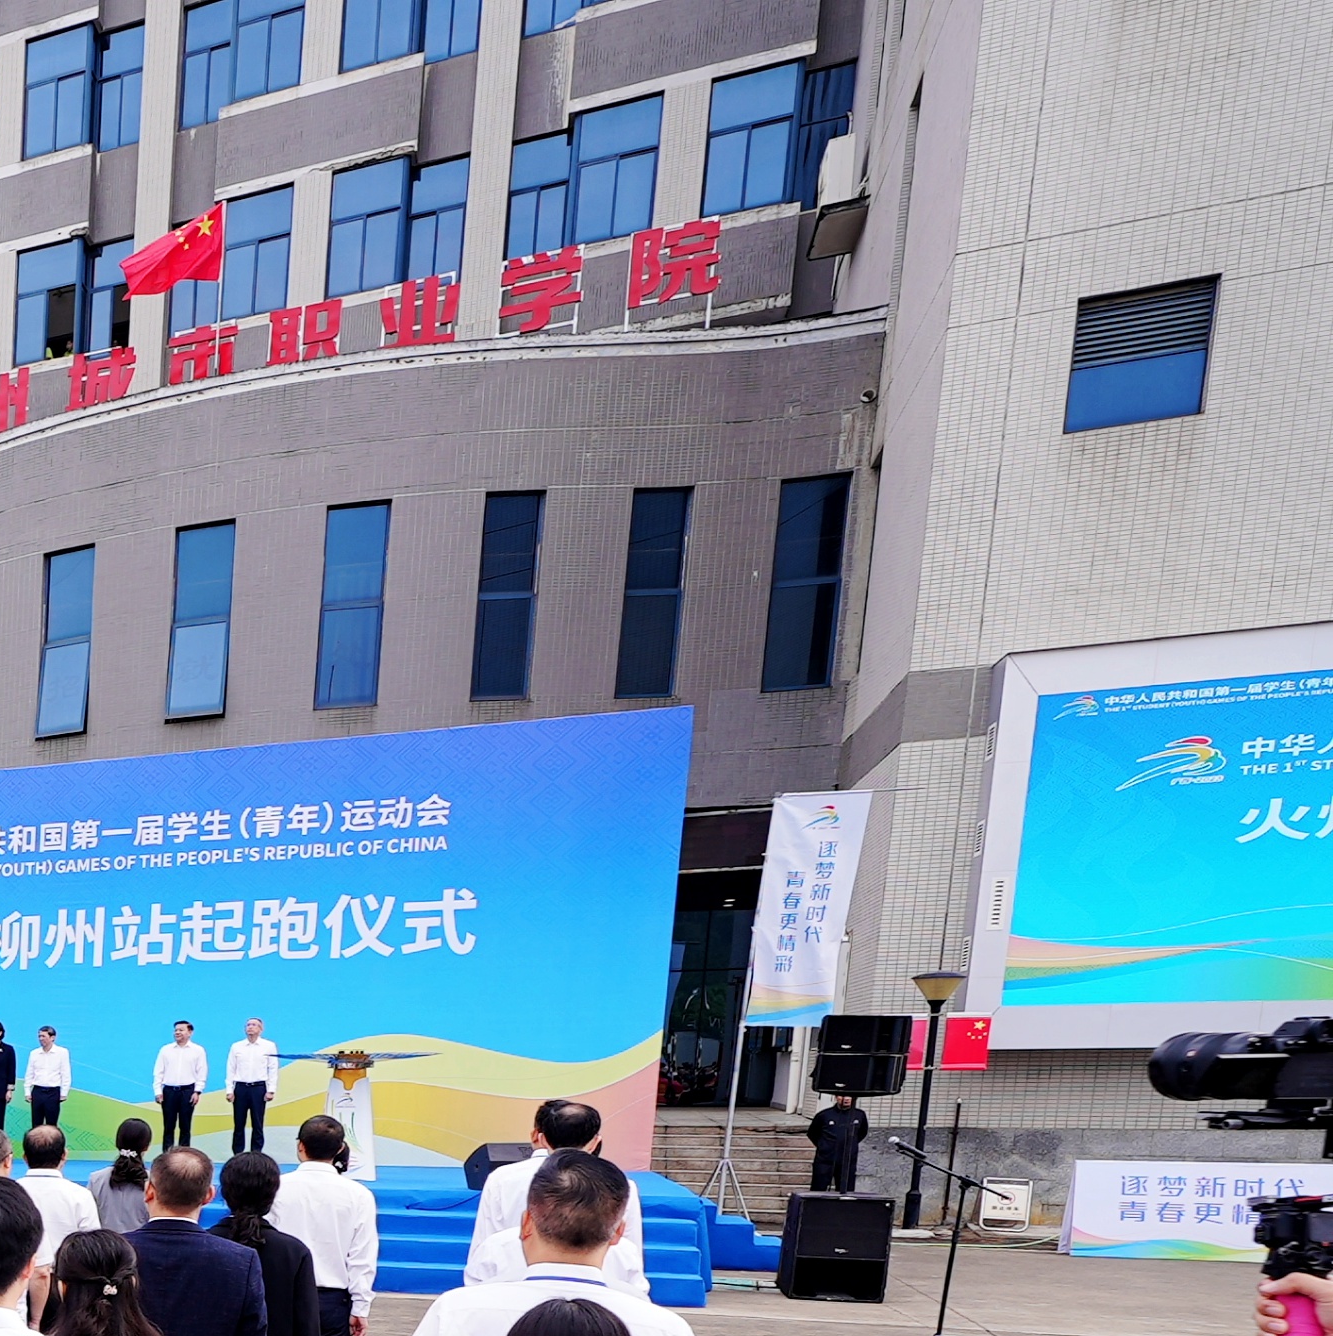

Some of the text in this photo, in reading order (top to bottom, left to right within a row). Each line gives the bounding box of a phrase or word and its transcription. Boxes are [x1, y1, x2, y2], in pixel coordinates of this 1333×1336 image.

[1240, 763, 1279, 776] THE
[1282, 759, 1308, 773] 1ST
[55, 857, 110, 875] GAMES
[114, 857, 136, 871] OF
[139, 853, 173, 868] THE
[176, 847, 261, 867] PEOPLE'S
[263, 840, 355, 862] REPUBLIC
[357, 840, 384, 855] OF
[386, 835, 448, 853] CHINA
[804, 840, 839, 944] 逐梦新时代
[774, 871, 806, 973] 青春更精彩
[1121, 1174, 1305, 1198] 逐梦新时代
